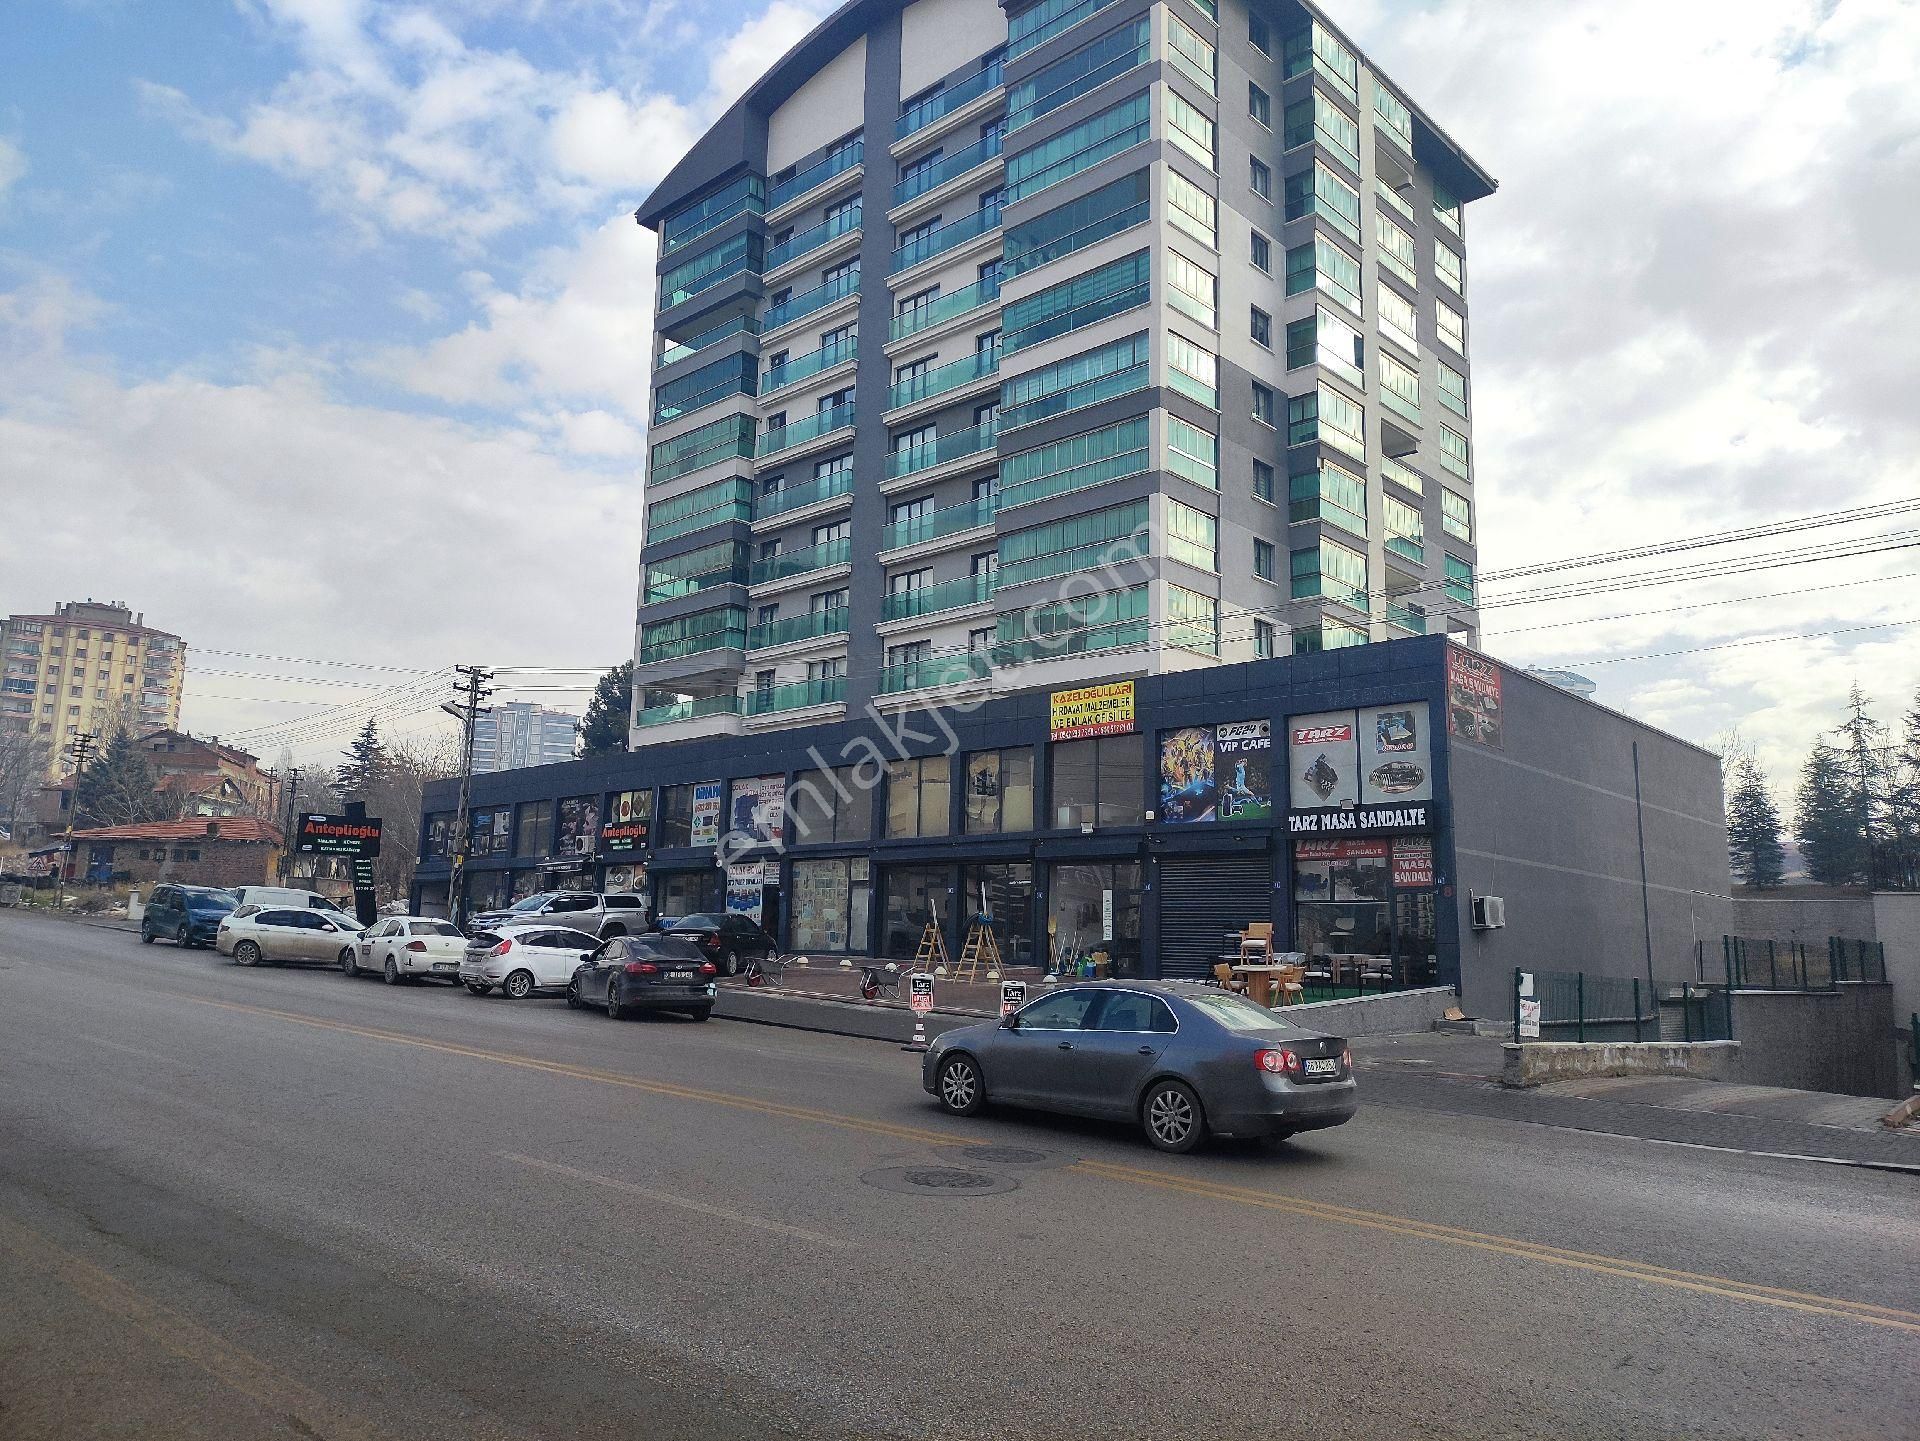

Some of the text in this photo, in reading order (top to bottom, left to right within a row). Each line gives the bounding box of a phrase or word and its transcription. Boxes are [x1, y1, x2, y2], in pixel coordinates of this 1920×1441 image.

[1297, 727, 1348, 740] TARZ
[1242, 739, 1270, 750] CAFE
[1289, 808, 1425, 831] TARZ MASA SANDALYE
[304, 822, 379, 838] Anteplioğlu
[602, 825, 647, 838] Anteplioğlu
[1400, 860, 1432, 869] MASA
[1007, 989, 1021, 997] Tarz
